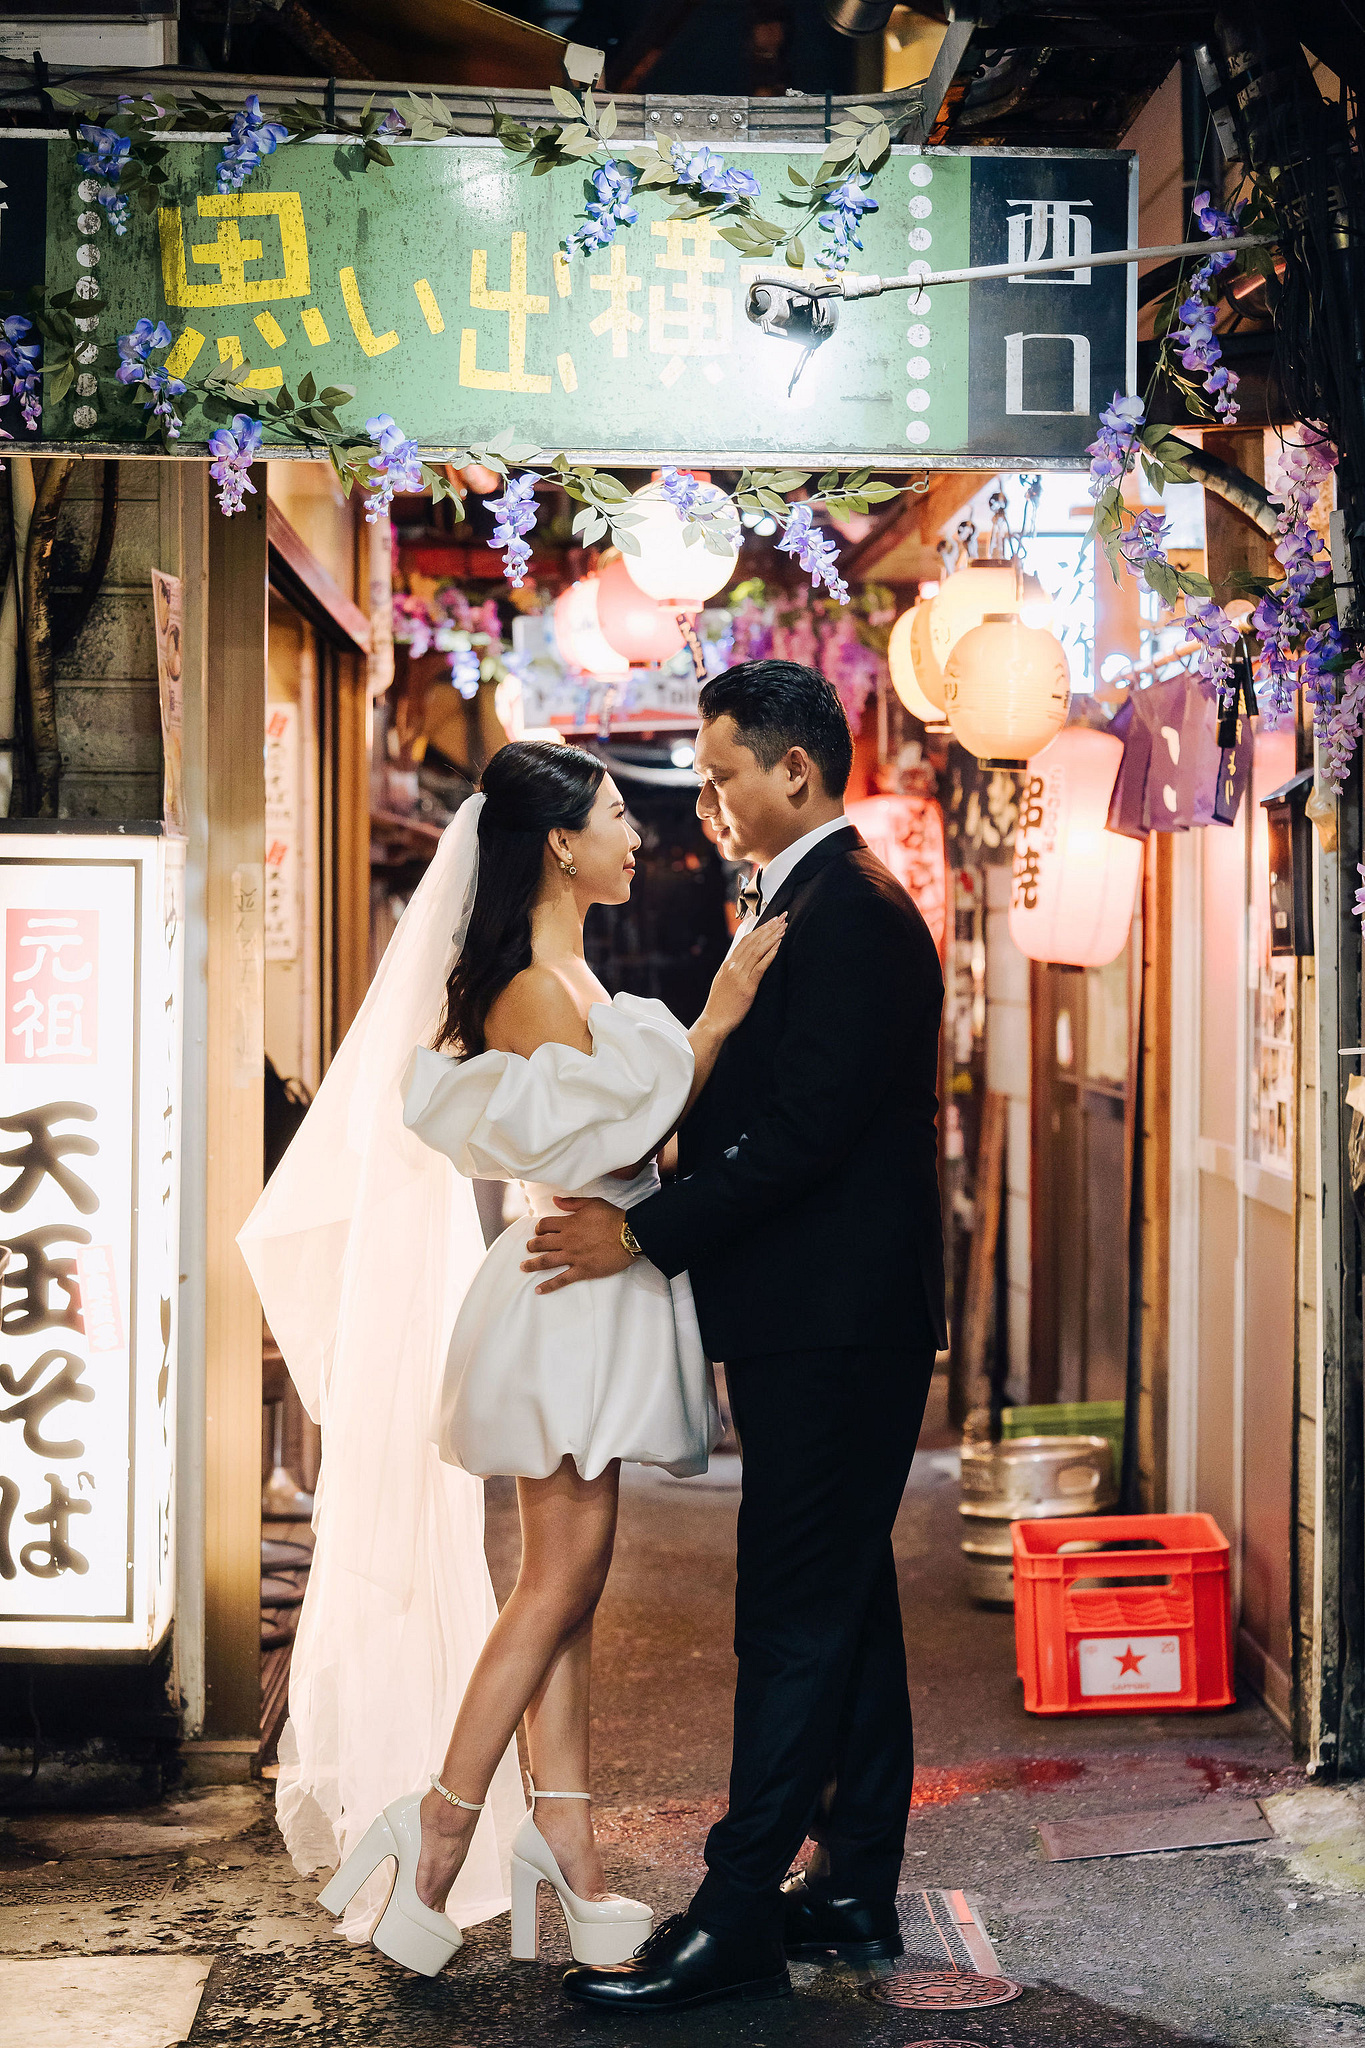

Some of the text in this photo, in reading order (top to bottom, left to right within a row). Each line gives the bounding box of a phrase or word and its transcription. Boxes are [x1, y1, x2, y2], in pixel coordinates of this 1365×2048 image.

[157, 191, 859, 394] 思い出横
[1005, 199, 1093, 417] 西口
[12, 917, 93, 1059] 元祖
